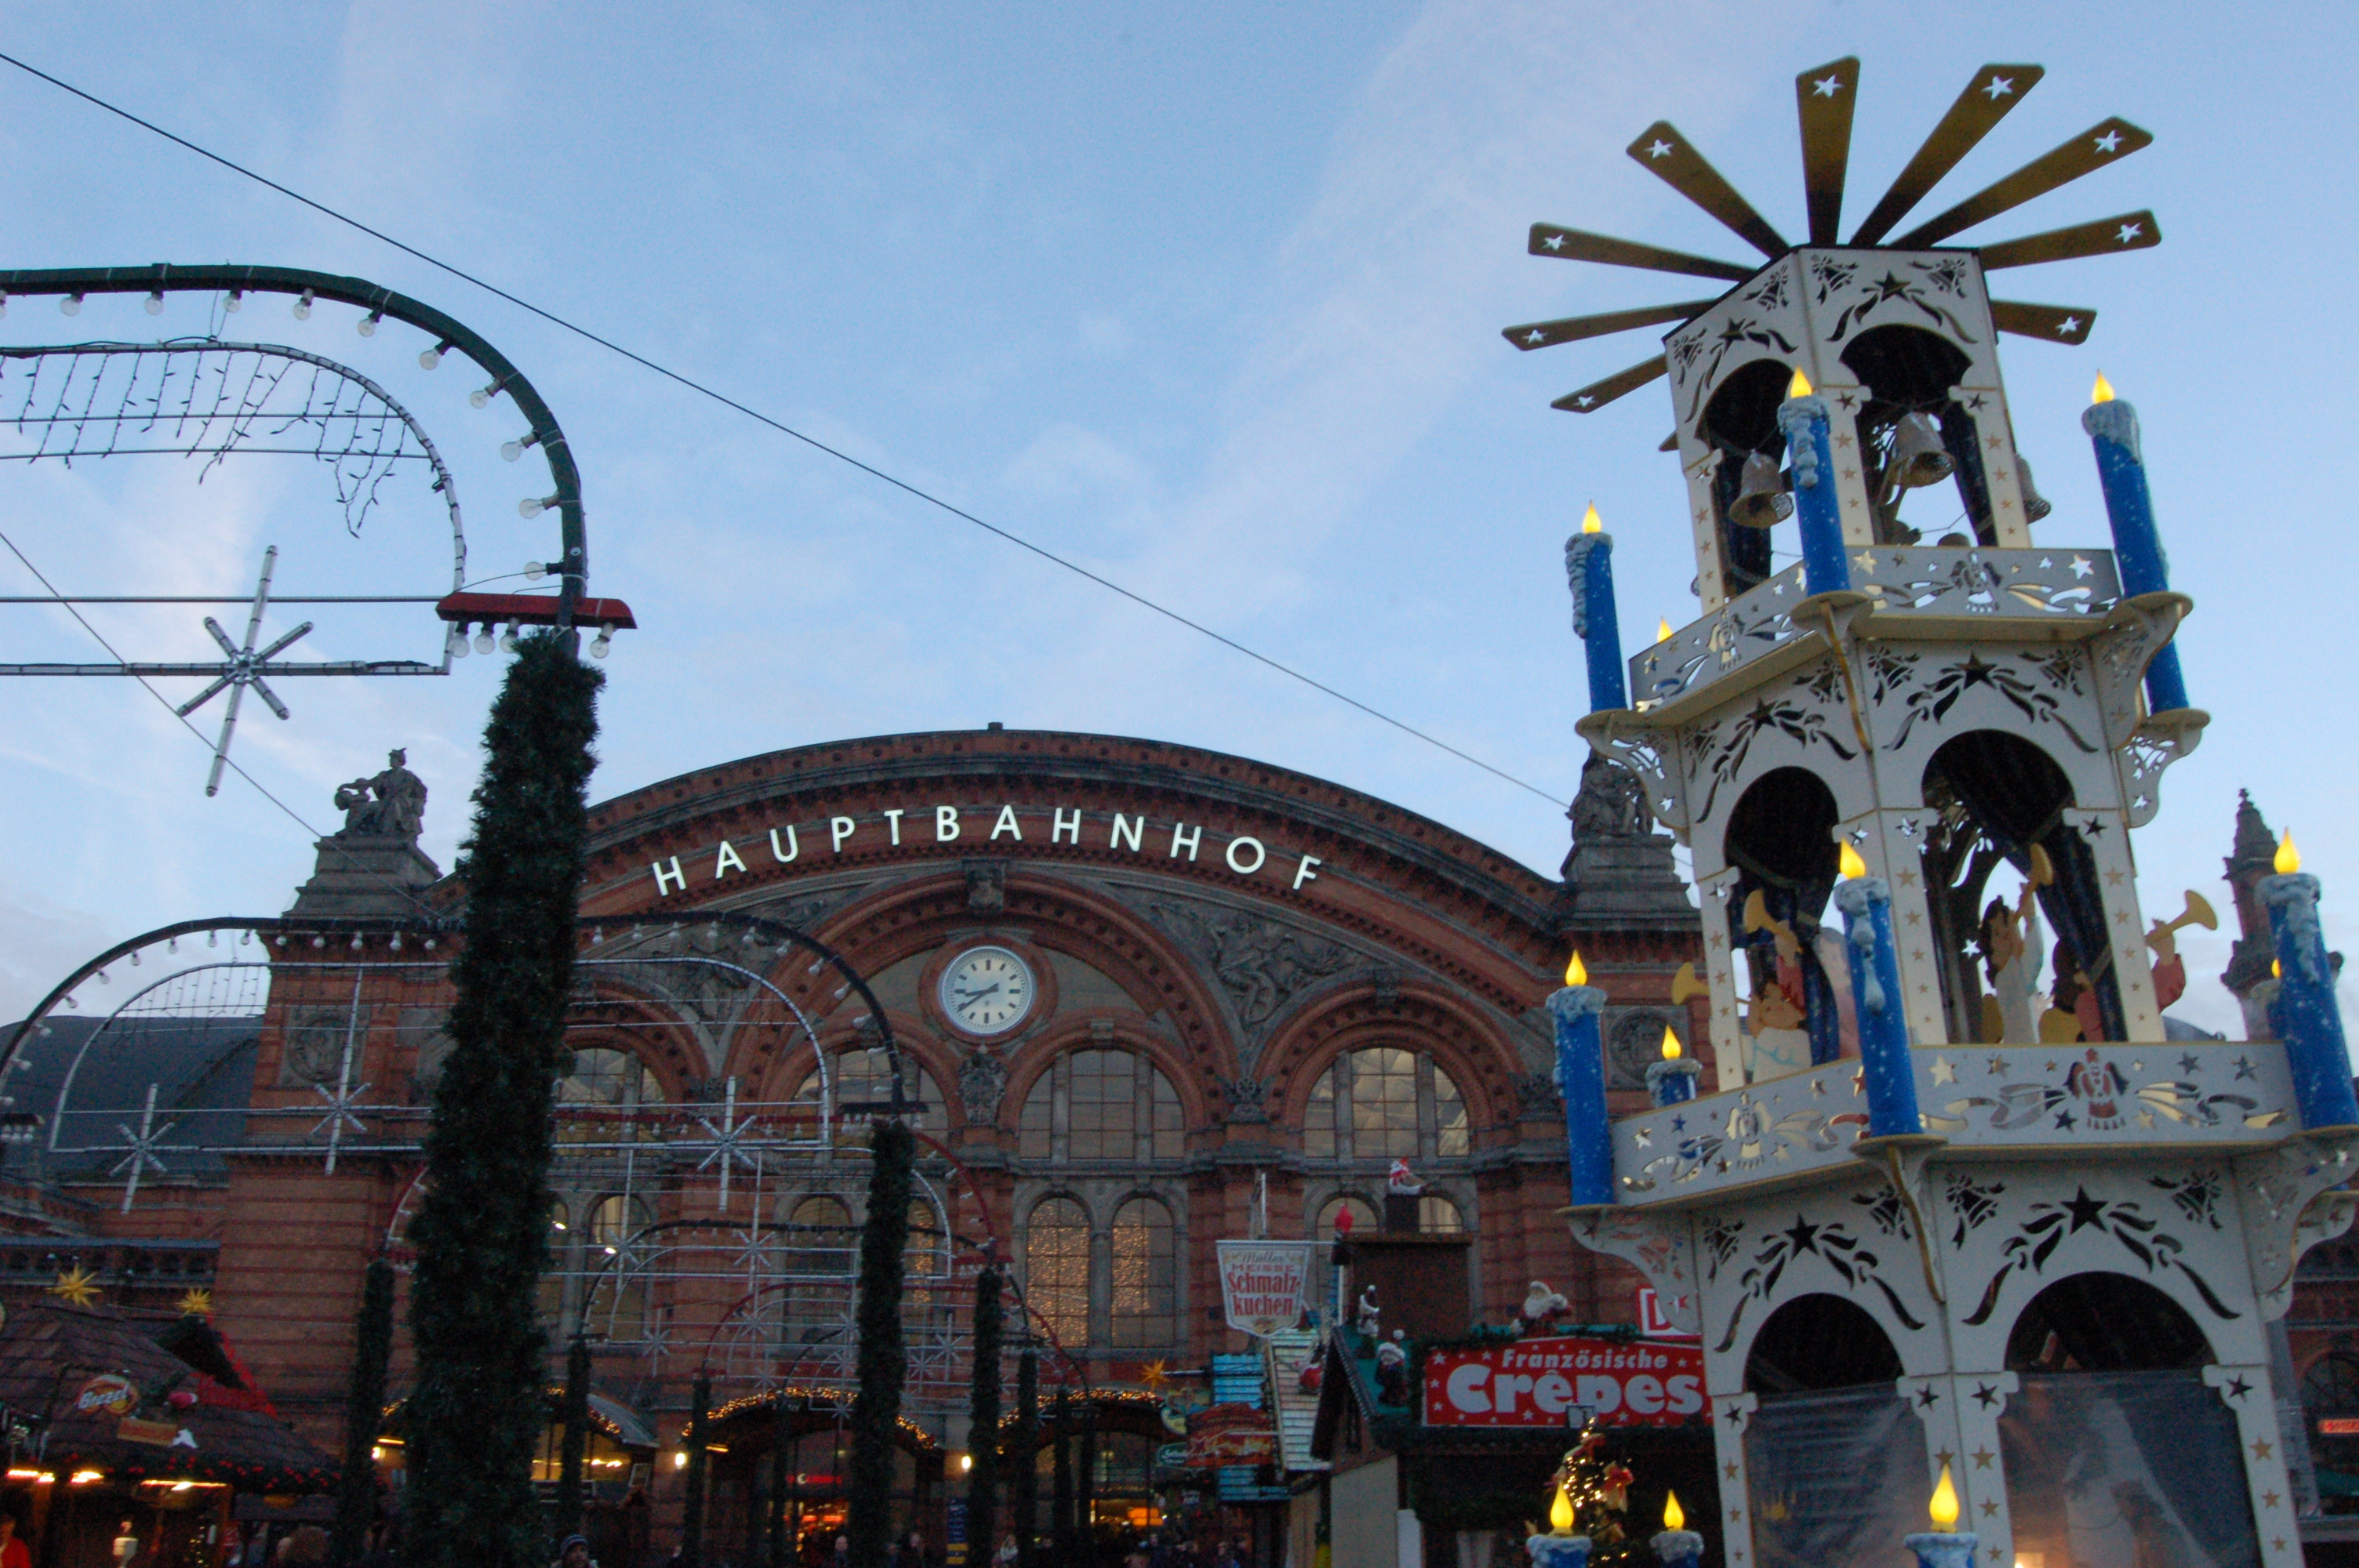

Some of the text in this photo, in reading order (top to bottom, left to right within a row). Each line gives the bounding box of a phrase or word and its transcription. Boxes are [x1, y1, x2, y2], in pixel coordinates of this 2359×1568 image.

[652, 804, 1321, 895] HAUPTBAHNHOF
[1227, 1272, 1301, 1294] Schmalz-
[1233, 1294, 1293, 1316] kuchen
[1502, 1348, 1668, 1370] Französische
[1446, 1363, 1704, 1414] Crêpes
